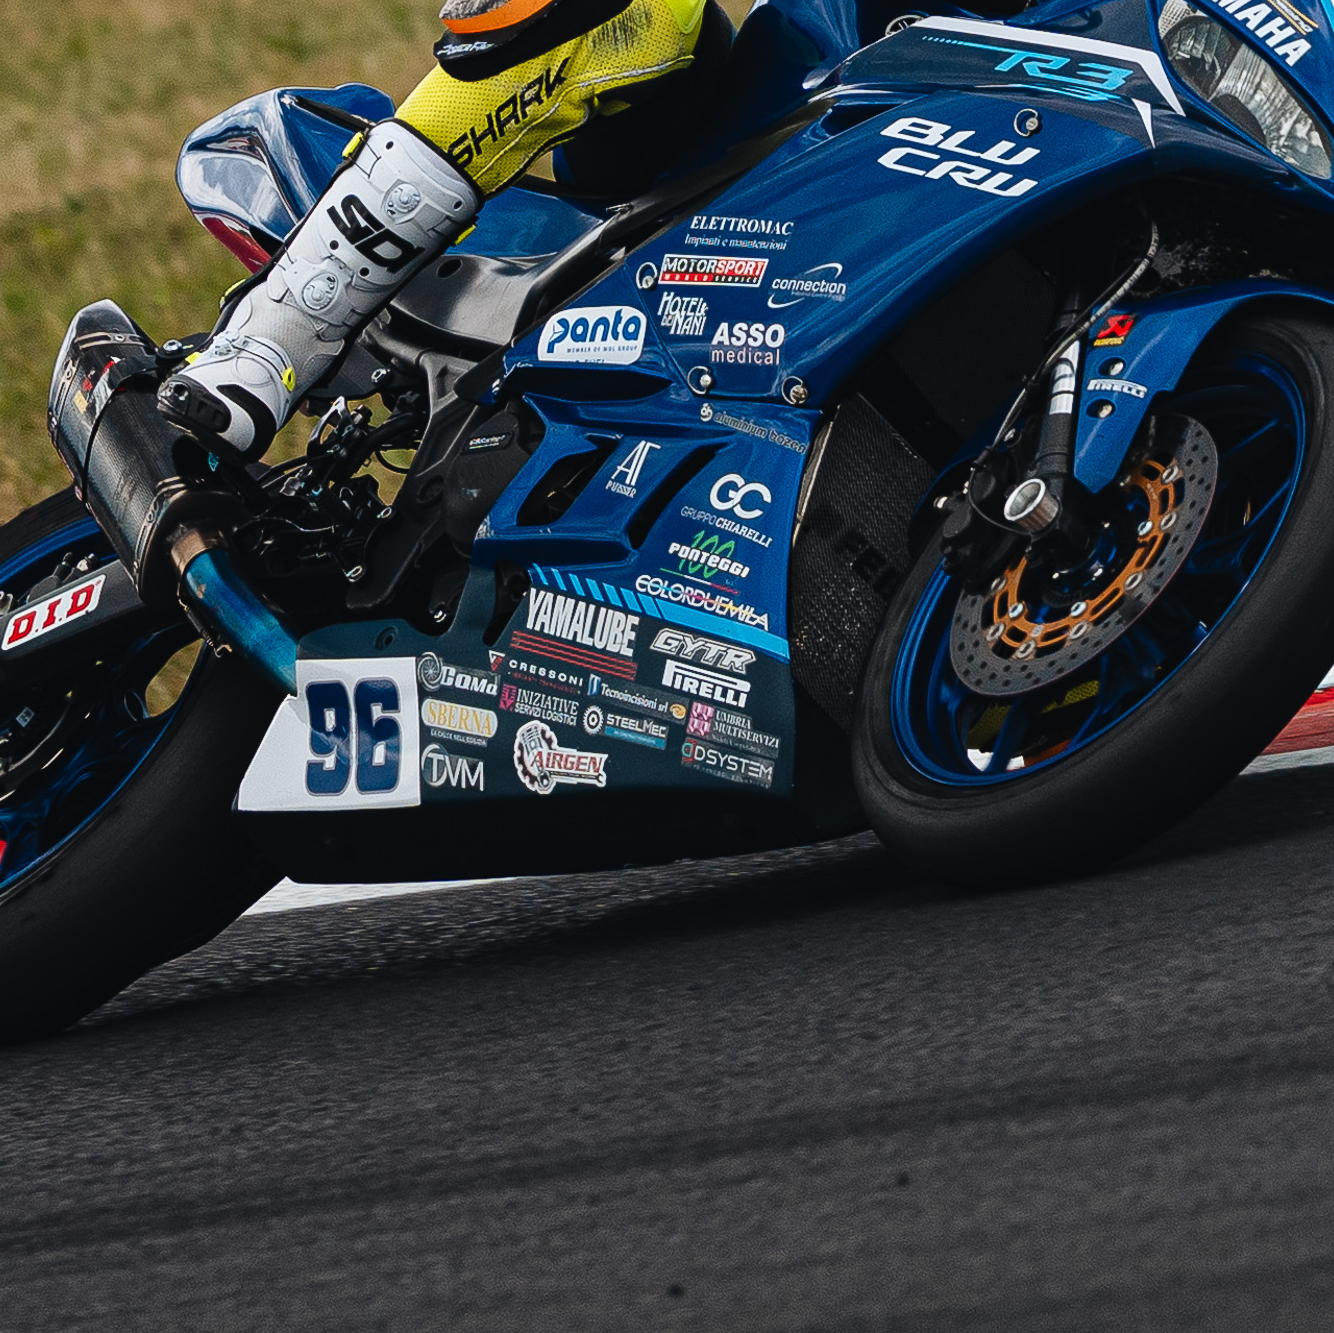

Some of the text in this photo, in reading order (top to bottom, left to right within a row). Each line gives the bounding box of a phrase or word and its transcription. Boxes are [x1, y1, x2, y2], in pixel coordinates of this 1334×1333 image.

[995, 50, 1134, 91] R3
[446, 56, 574, 168] SHARK
[880, 116, 1041, 165] BLU
[877, 147, 1039, 197] CRU
[690, 216, 794, 236] ELETTROMAC
[663, 257, 765, 276] MOTORSPORT
[771, 277, 847, 295] connection
[669, 313, 707, 335] NANI
[711, 322, 785, 348] ASSO
[711, 347, 780, 365] medical
[1086, 378, 1148, 399] PIRELLI
[713, 411, 809, 454] aluminium bozen
[635, 574, 769, 631] COLORDUEMILA
[525, 587, 640, 657] YAMALUBE
[650, 628, 756, 674] GYTR
[509, 659, 584, 686] CRESSONI
[661, 659, 752, 708] PIRELLI
[516, 688, 579, 716] INIZIATIVE
[601, 683, 658, 711] Tecnoincisioni
[427, 701, 492, 737] SBERNA
[716, 710, 752, 730] UMBRIA
[305, 676, 402, 797] 96
[713, 721, 781, 749] MULTISERVIZI
[427, 751, 484, 792] TVM
[530, 750, 604, 774] AIRGEN
